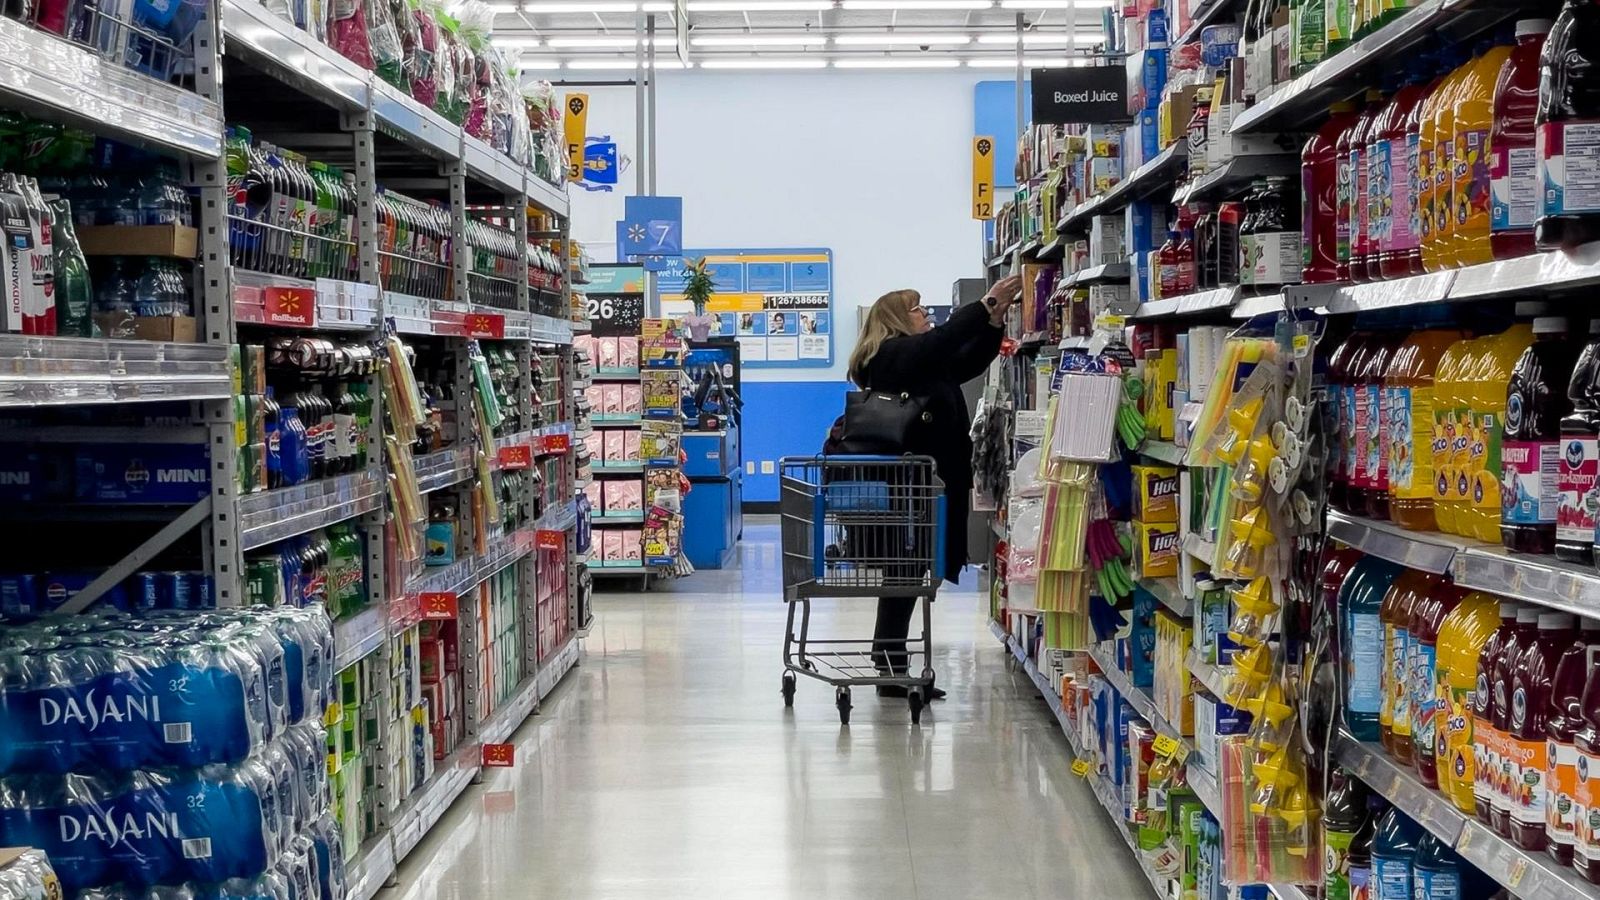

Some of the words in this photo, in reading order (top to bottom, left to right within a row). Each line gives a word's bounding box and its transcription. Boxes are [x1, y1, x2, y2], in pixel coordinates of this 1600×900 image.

[1054, 91, 1088, 103] Boxed
[1090, 90, 1118, 103] Juice
[569, 143, 579, 160] F
[978, 183, 988, 197] F
[976, 204, 990, 216] 12
[655, 225, 670, 246] 7
[587, 299, 614, 320] 26
[271, 313, 306, 323] Rollback
[0, 472, 31, 485] INI
[157, 469, 206, 483] MINI
[169, 678, 188, 693] 32
[39, 688, 161, 732] DASANI
[187, 795, 204, 808] 32
[59, 806, 180, 848] DASANI
